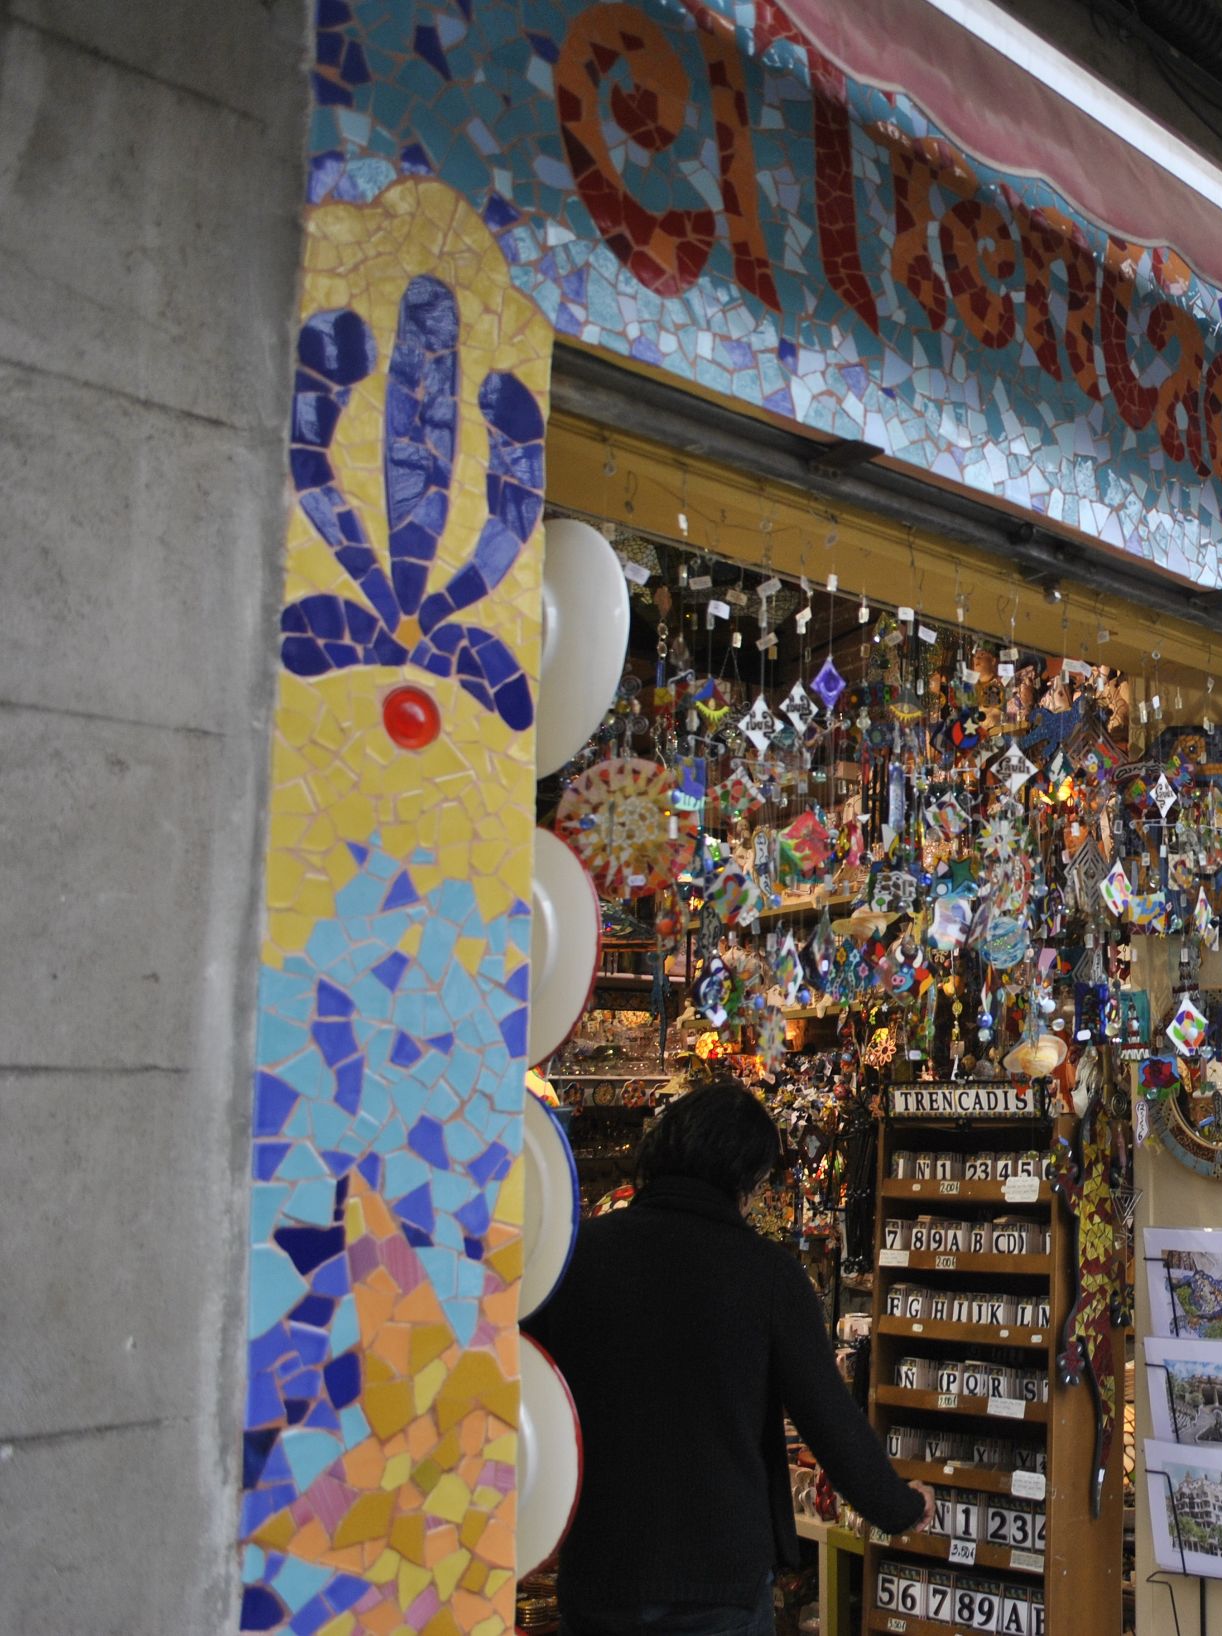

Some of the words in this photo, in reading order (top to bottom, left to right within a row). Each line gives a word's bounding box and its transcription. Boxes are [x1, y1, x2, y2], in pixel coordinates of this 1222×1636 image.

[900, 1090, 1028, 1112] TRENCADIS
[961, 1506, 972, 1537] 1
[989, 1510, 1008, 1542] 2
[1012, 1514, 1029, 1545] 3
[879, 1575, 895, 1606] 5
[901, 1583, 917, 1611] 6
[932, 1586, 949, 1617] 7
[957, 1592, 975, 1622] 8
[977, 1596, 995, 1627] 9
[1004, 1601, 1025, 1634] A
